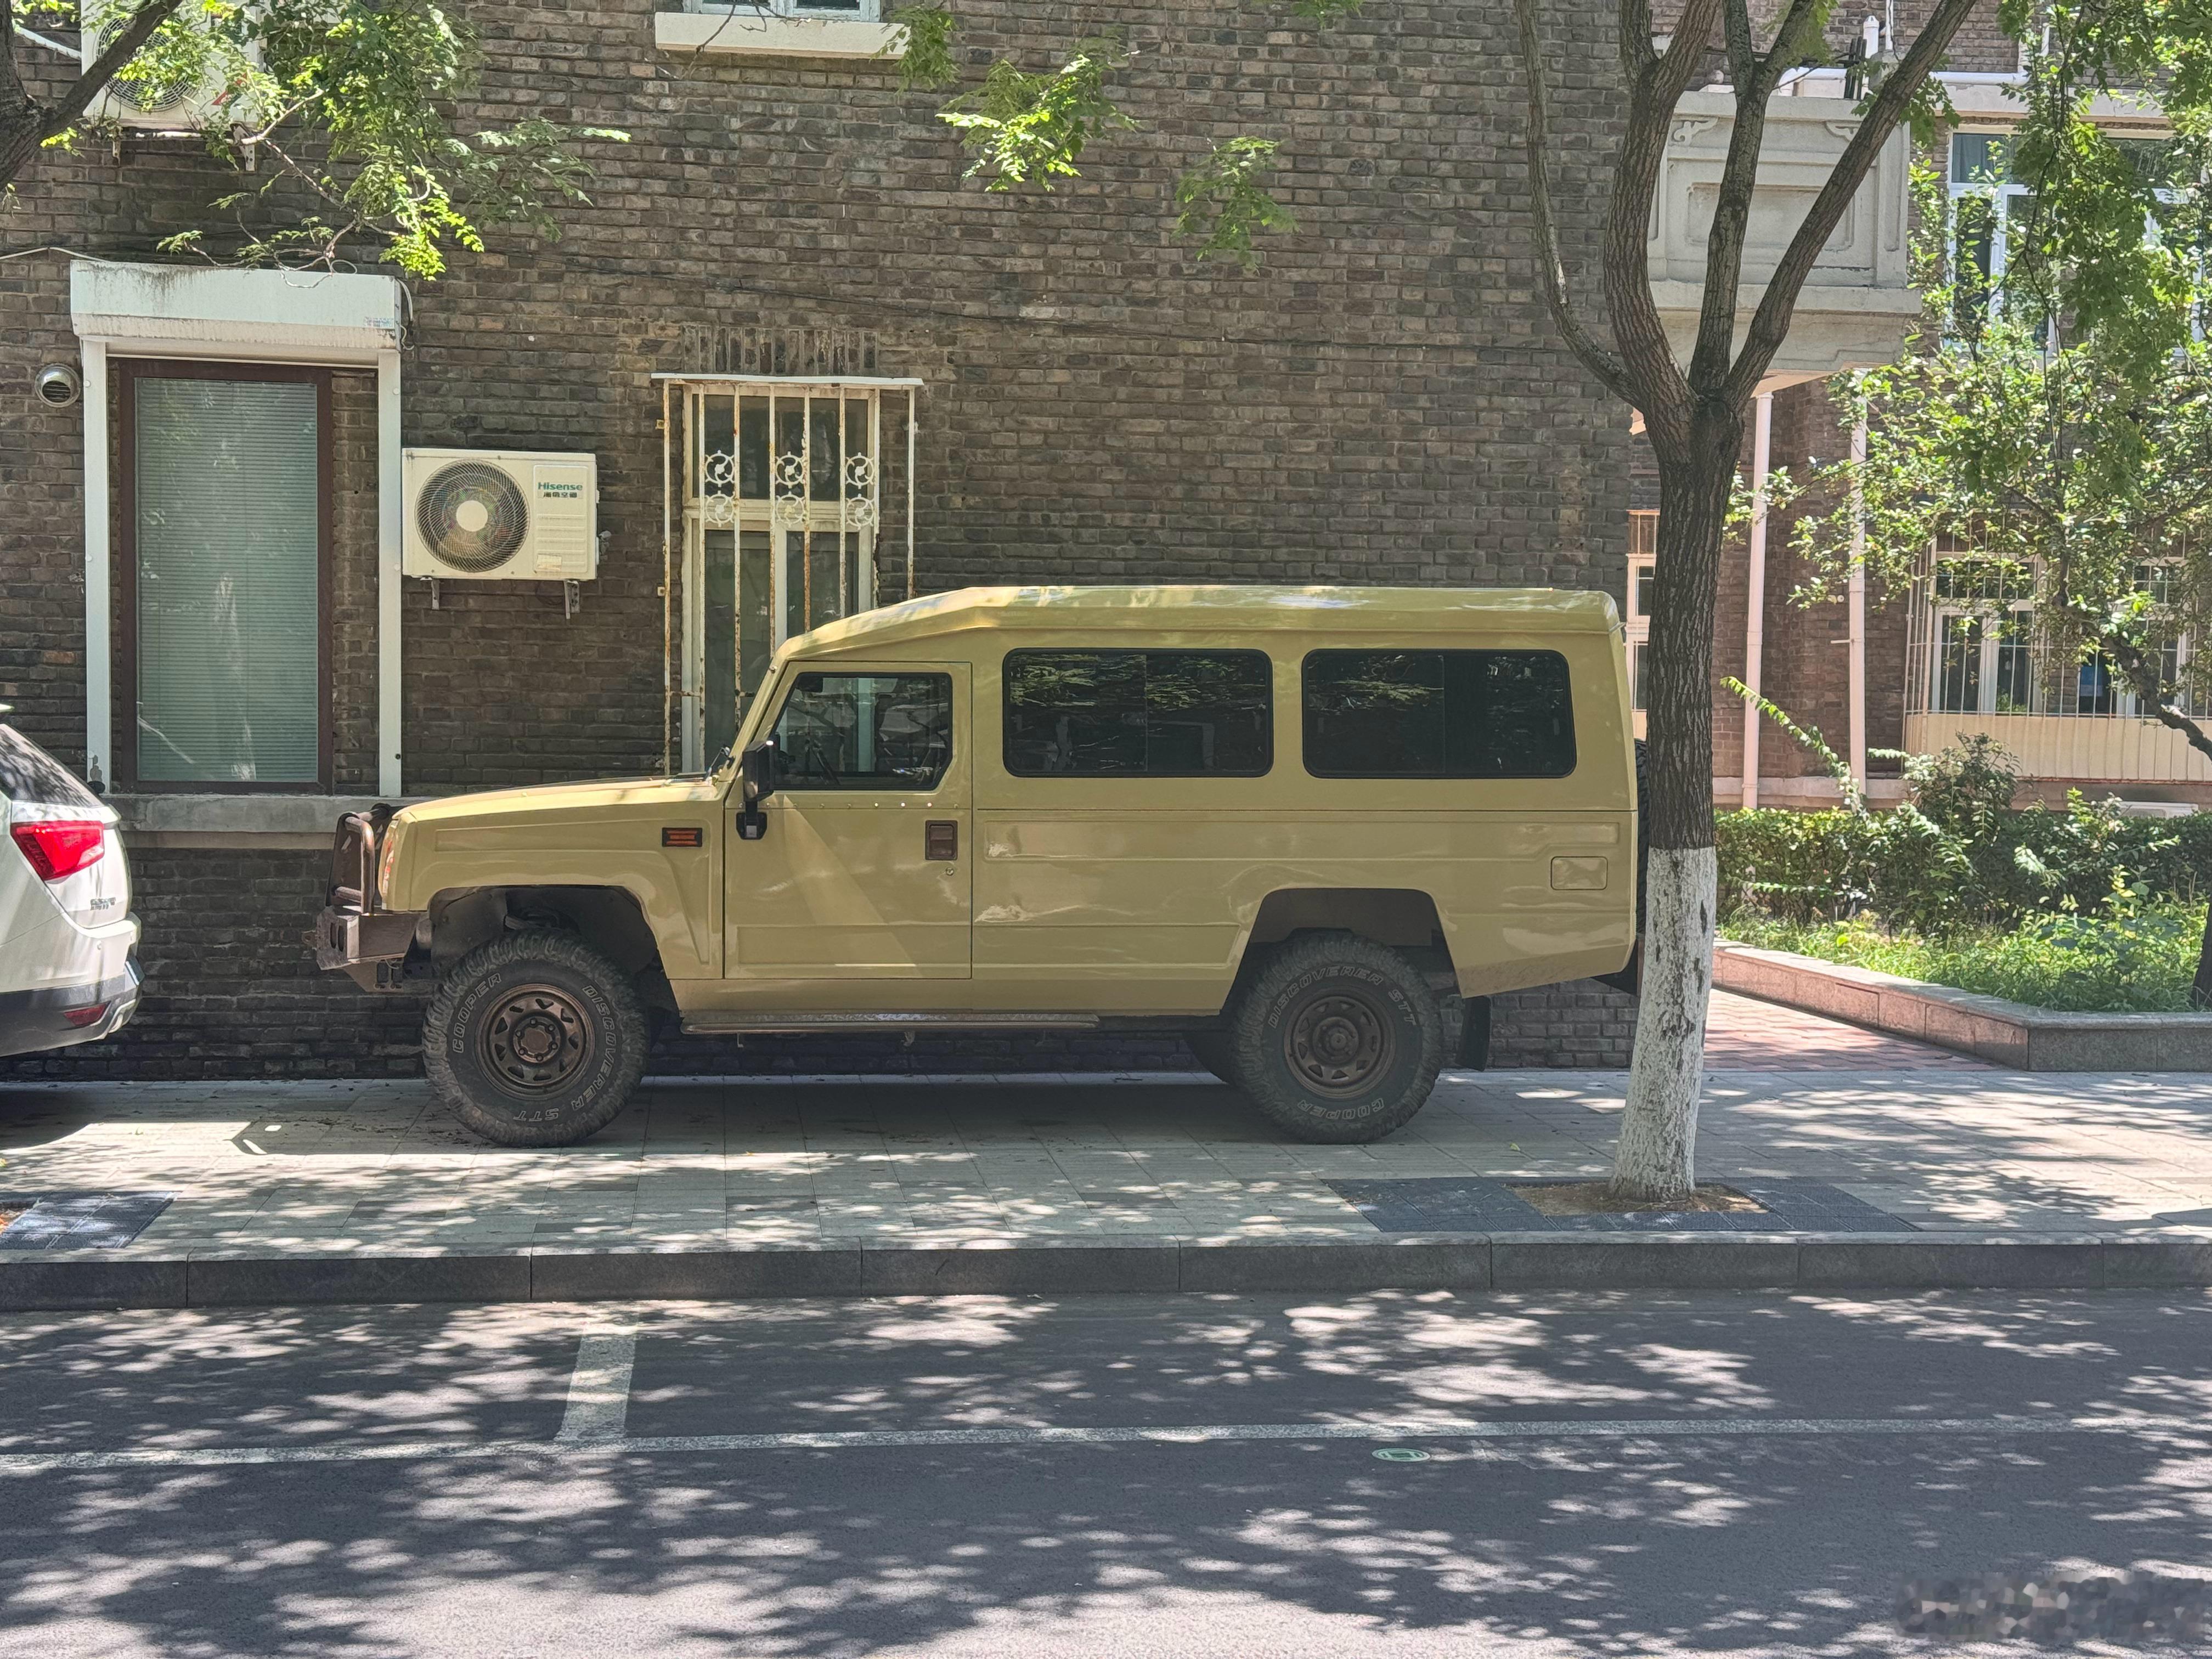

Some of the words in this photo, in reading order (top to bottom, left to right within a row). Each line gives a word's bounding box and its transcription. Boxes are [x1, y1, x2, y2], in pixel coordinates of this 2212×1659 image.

[538, 482, 583, 490] Hisense
[453, 973, 501, 1053] COOPER
[1268, 966, 1383, 1029] DISCOVERER
[1388, 989, 1416, 1026] STT
[571, 985, 617, 1110] DISCOVERER
[514, 1108, 560, 1122] STT
[1297, 1098, 1384, 1120] COOPER
